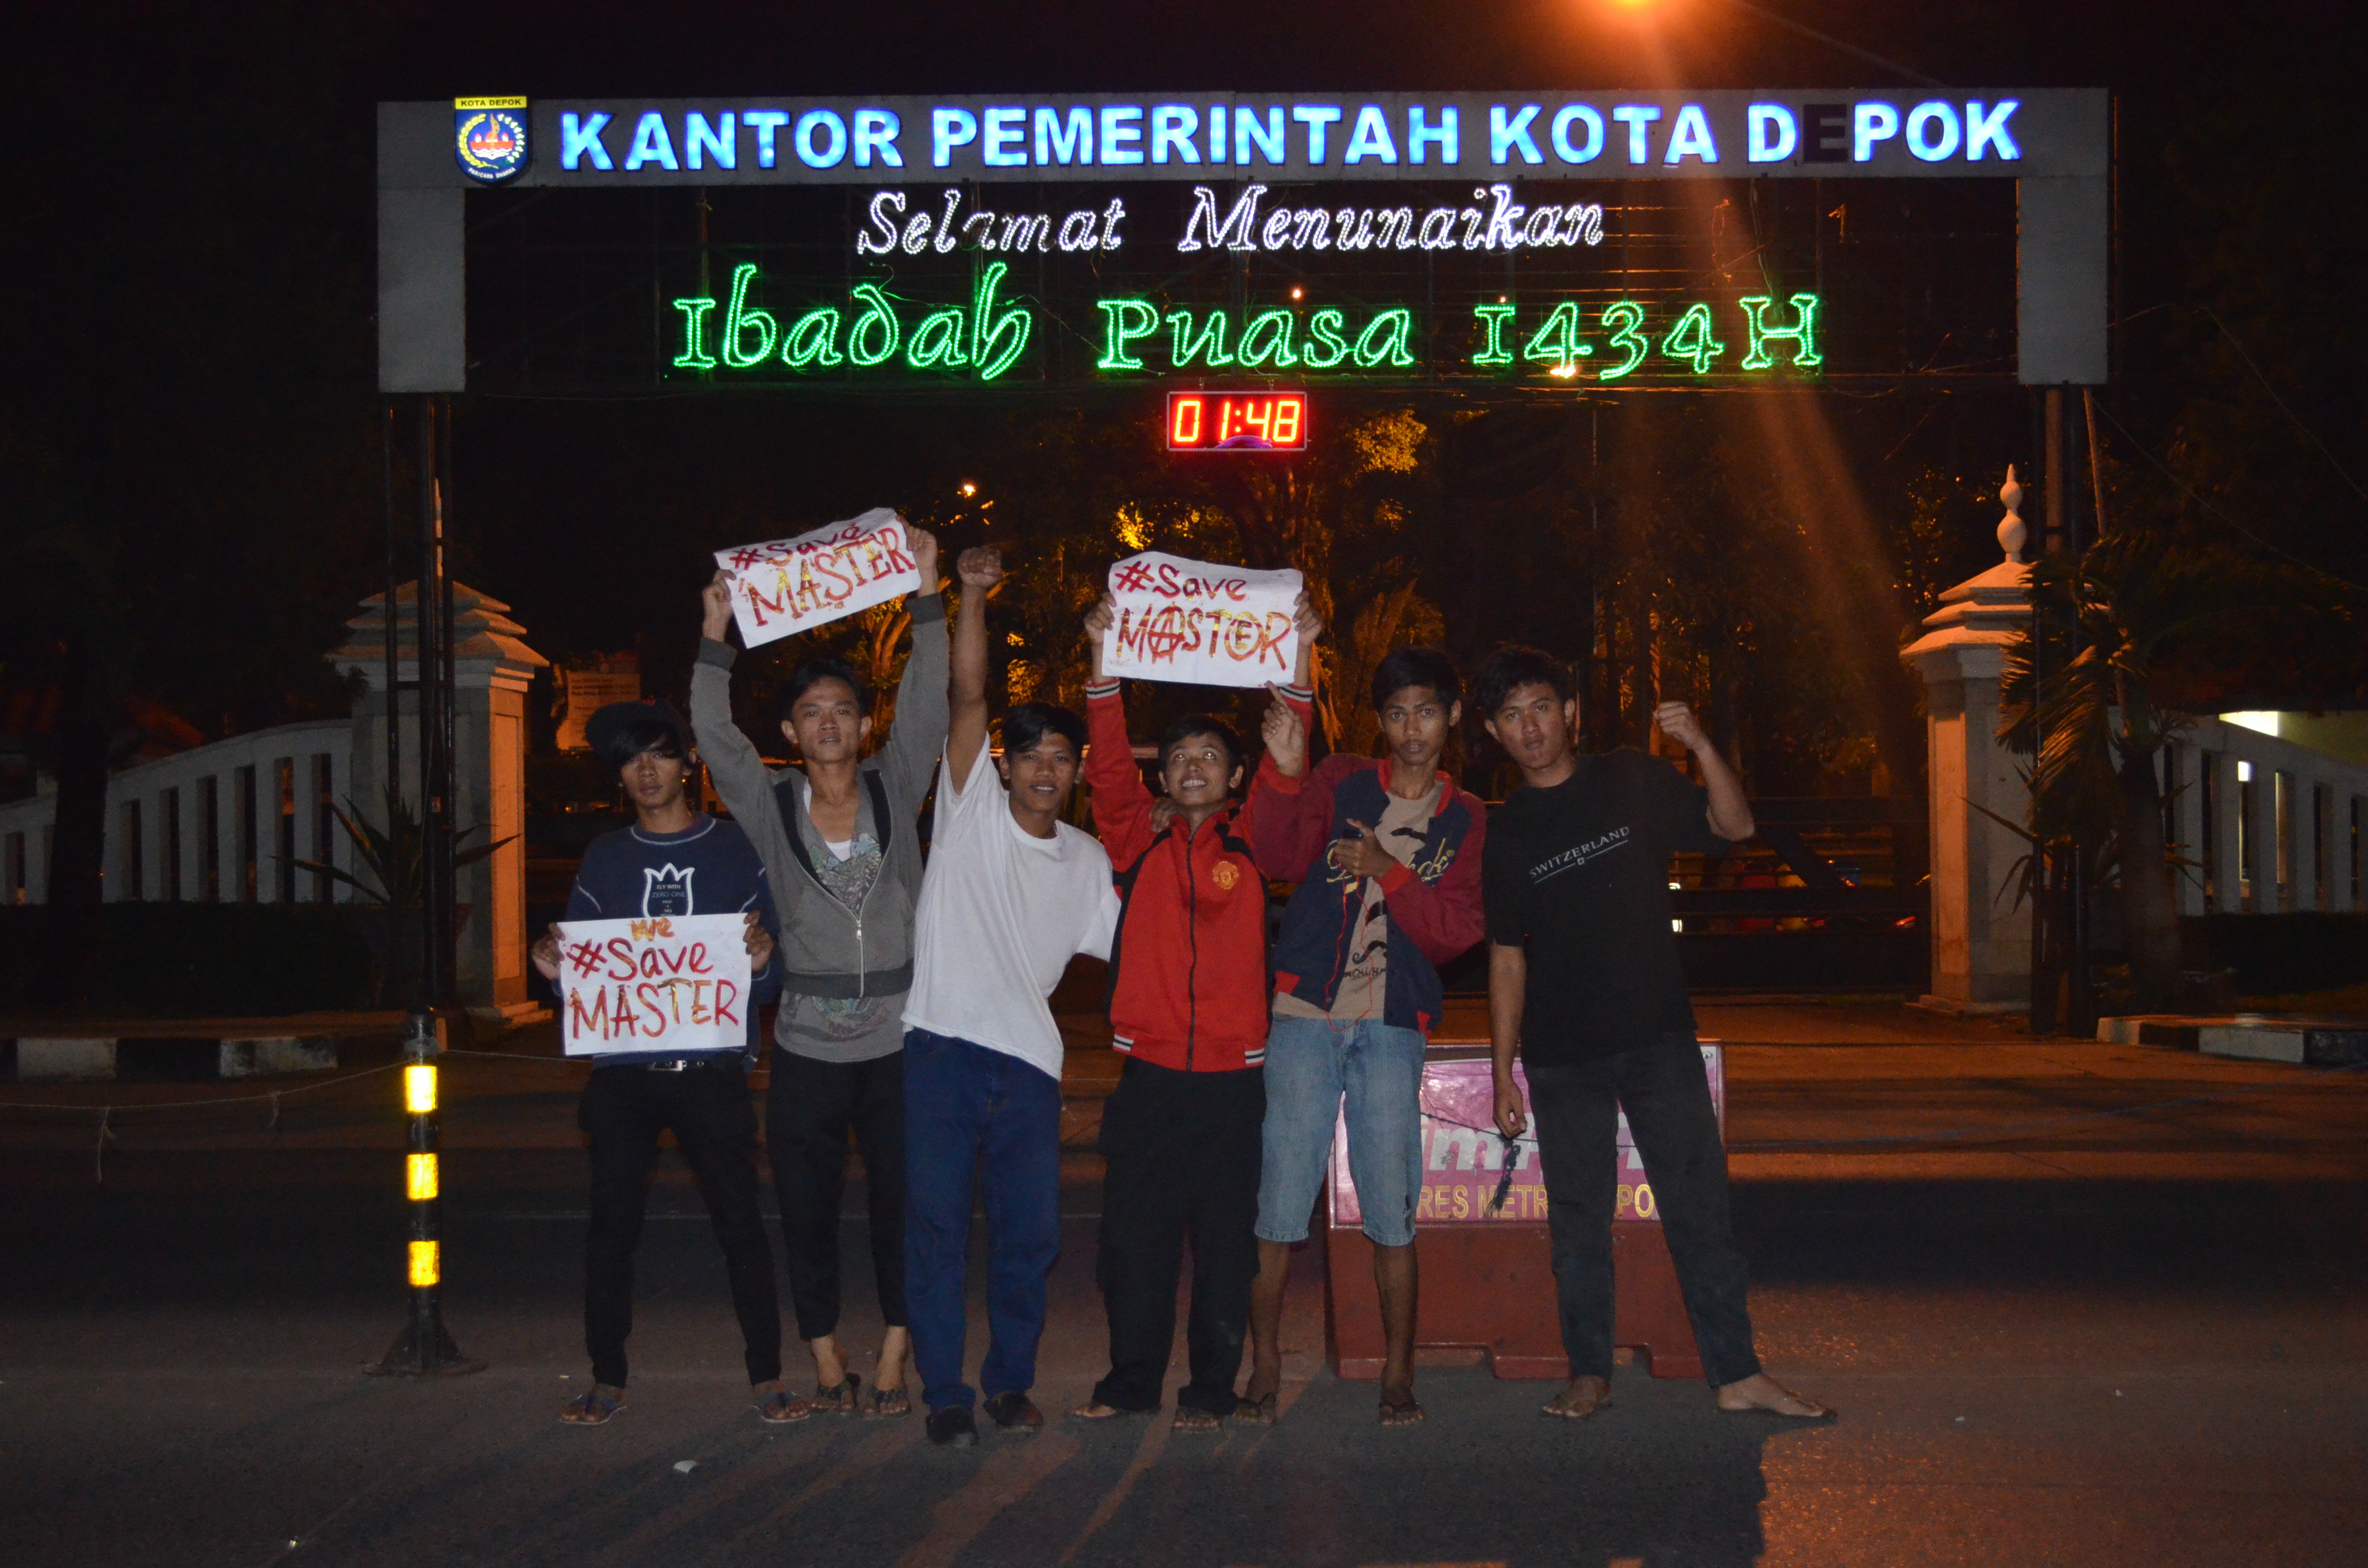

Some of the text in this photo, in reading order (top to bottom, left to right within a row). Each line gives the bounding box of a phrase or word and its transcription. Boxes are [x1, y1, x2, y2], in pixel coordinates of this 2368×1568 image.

[560, 98, 2021, 170] KANTOR PEMERINTAH KOTA DEPOK
[857, 183, 1604, 255] Selamat Menunaikan
[673, 261, 1032, 381] Ibadah
[1096, 298, 1415, 375] Puasa
[1174, 399, 1301, 443] 01:48
[745, 527, 916, 626] MASTER
[1115, 560, 1247, 601] #Save
[1116, 601, 1287, 671] MASTER
[1529, 826, 1629, 878] SWITZERLAND
[566, 936, 713, 981] #Save
[571, 977, 739, 1041] MASTER
[1477, 1185, 1548, 1218] METR
